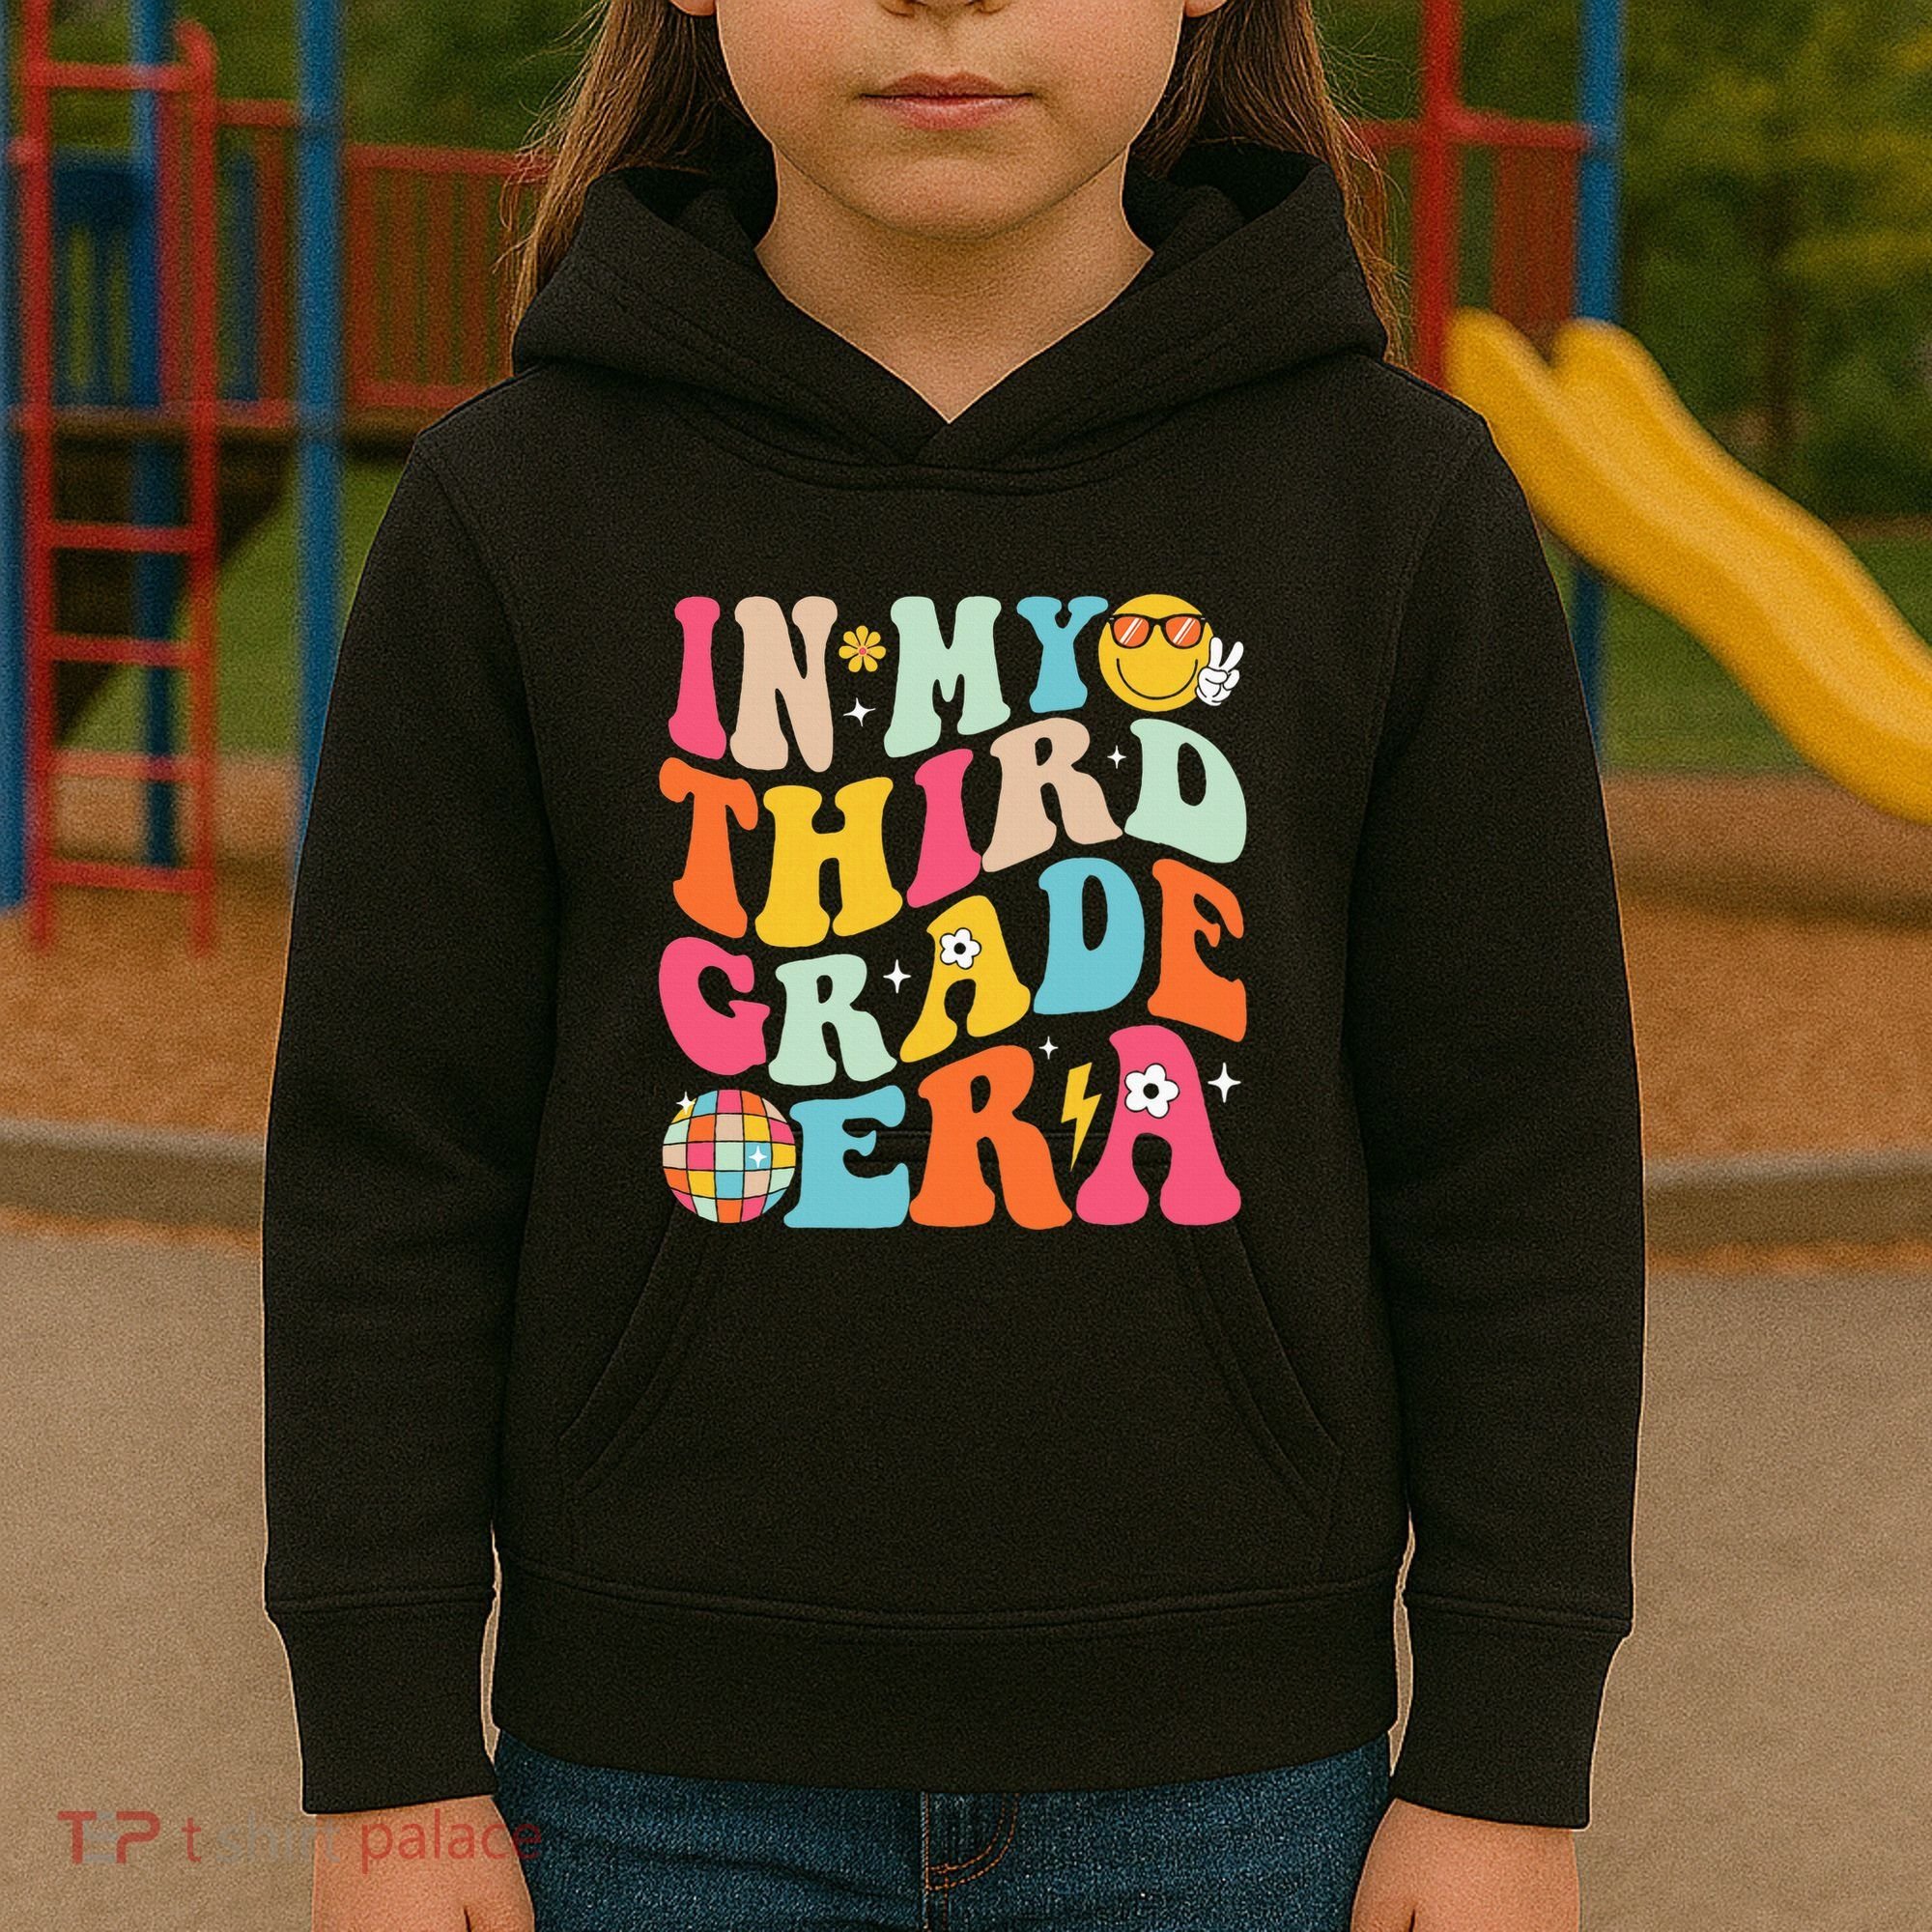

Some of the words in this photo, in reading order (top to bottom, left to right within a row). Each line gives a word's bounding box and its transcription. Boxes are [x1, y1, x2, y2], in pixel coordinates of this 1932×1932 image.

[668, 596, 838, 772] IN
[884, 596, 1108, 757] MY
[659, 718, 1246, 948] THIRD
[659, 858, 1246, 1086] GRADE
[784, 1025, 1241, 1230] ERA
